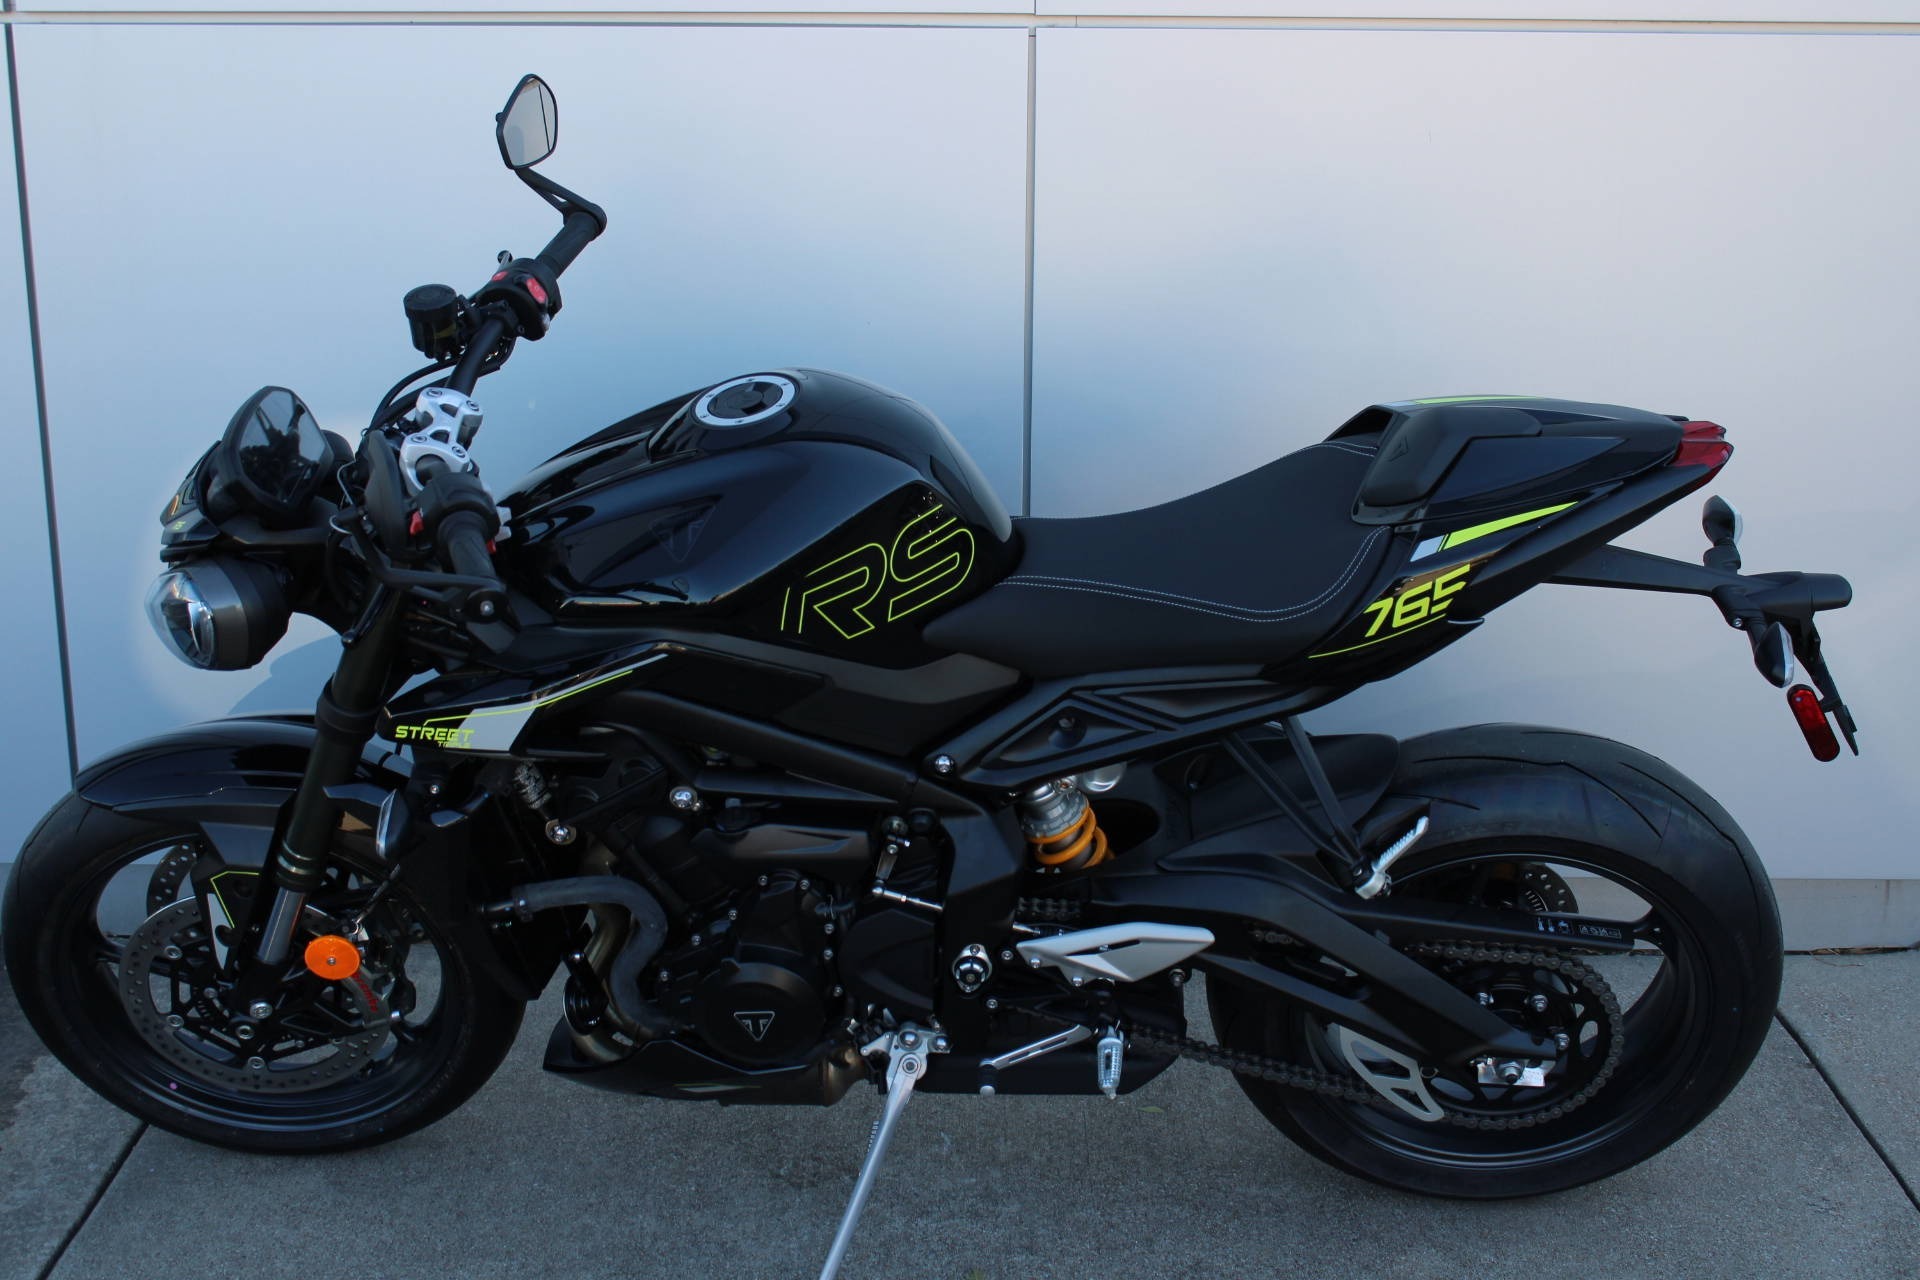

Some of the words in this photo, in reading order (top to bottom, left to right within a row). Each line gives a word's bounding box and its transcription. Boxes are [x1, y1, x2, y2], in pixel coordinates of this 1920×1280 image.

[781, 503, 975, 640] RS
[1363, 563, 1471, 638] 765
[394, 725, 475, 743] STREET
